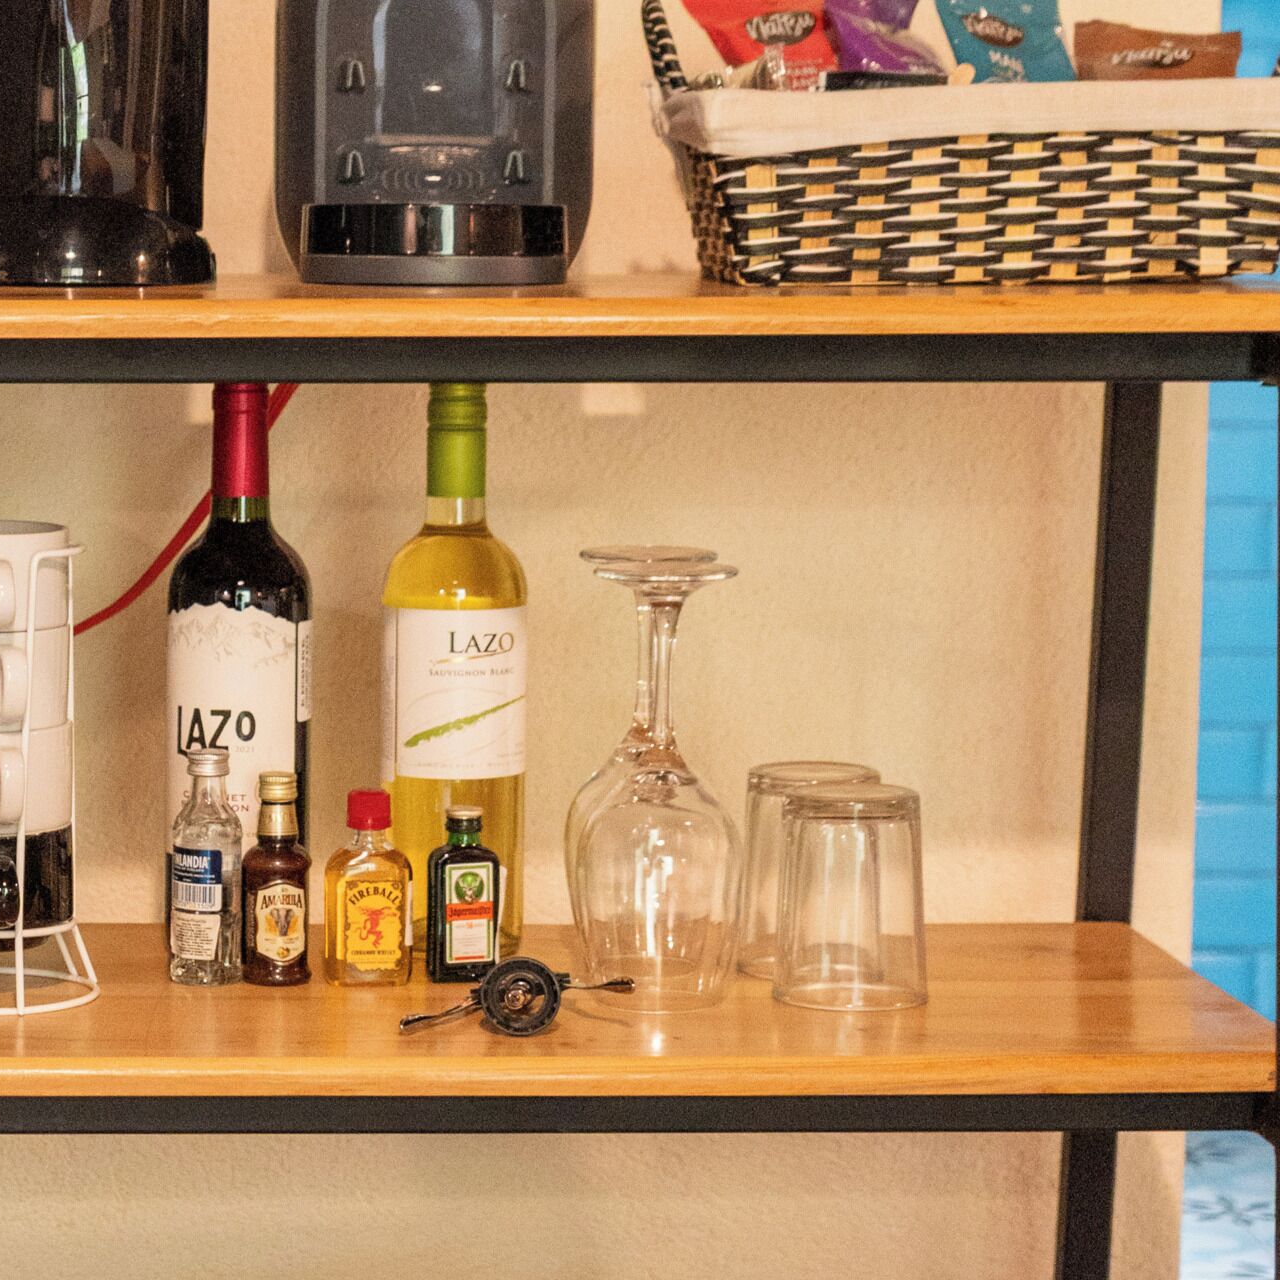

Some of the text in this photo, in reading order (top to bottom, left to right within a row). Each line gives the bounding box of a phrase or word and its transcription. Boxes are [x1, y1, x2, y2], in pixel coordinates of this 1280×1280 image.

[449, 631, 515, 654] LAZO
[429, 669, 486, 677] SAUVIGNON
[177, 705, 256, 756] LAZO
[261, 893, 303, 910] AMARULA
[348, 886, 401, 907] FIREBALL
